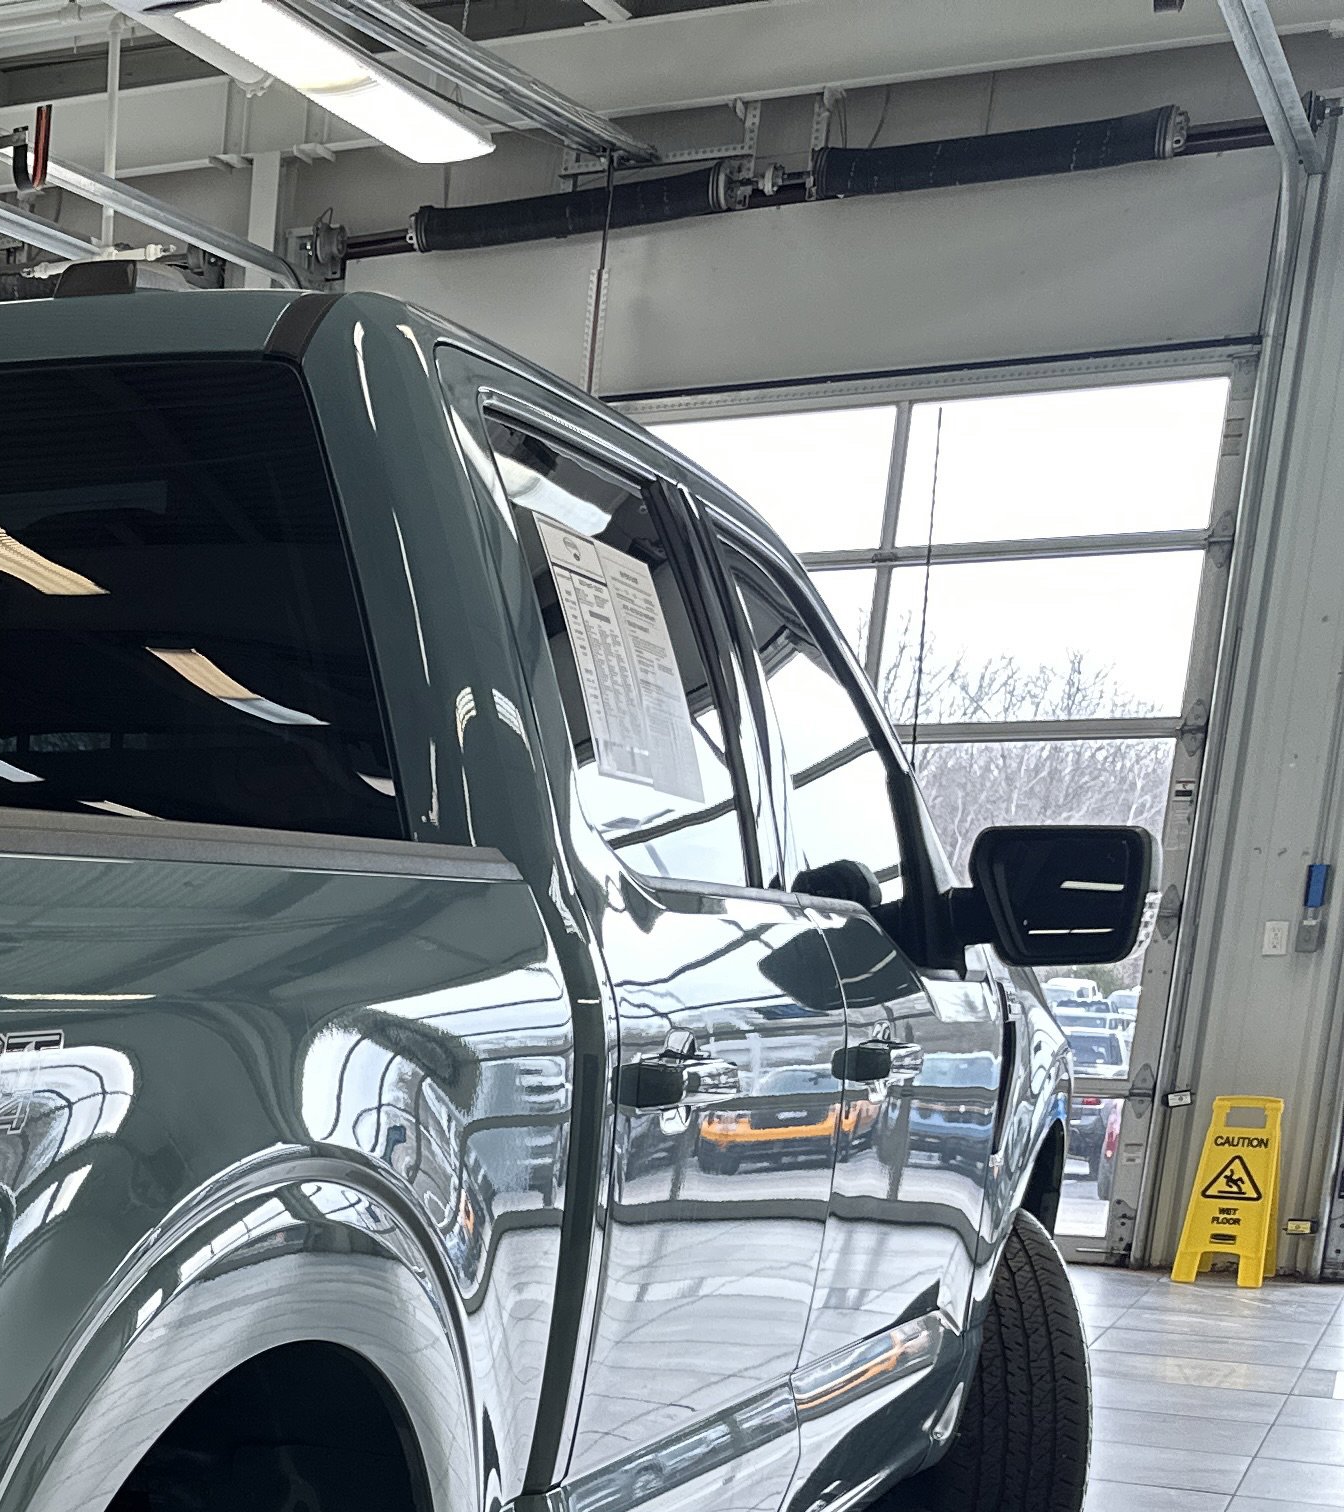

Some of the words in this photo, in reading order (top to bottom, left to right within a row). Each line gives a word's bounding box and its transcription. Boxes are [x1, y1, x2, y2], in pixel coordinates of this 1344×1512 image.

[1214, 1135, 1270, 1149] CAUTION
[1218, 1206, 1240, 1216] WET
[1211, 1215, 1242, 1226] FLOOR
